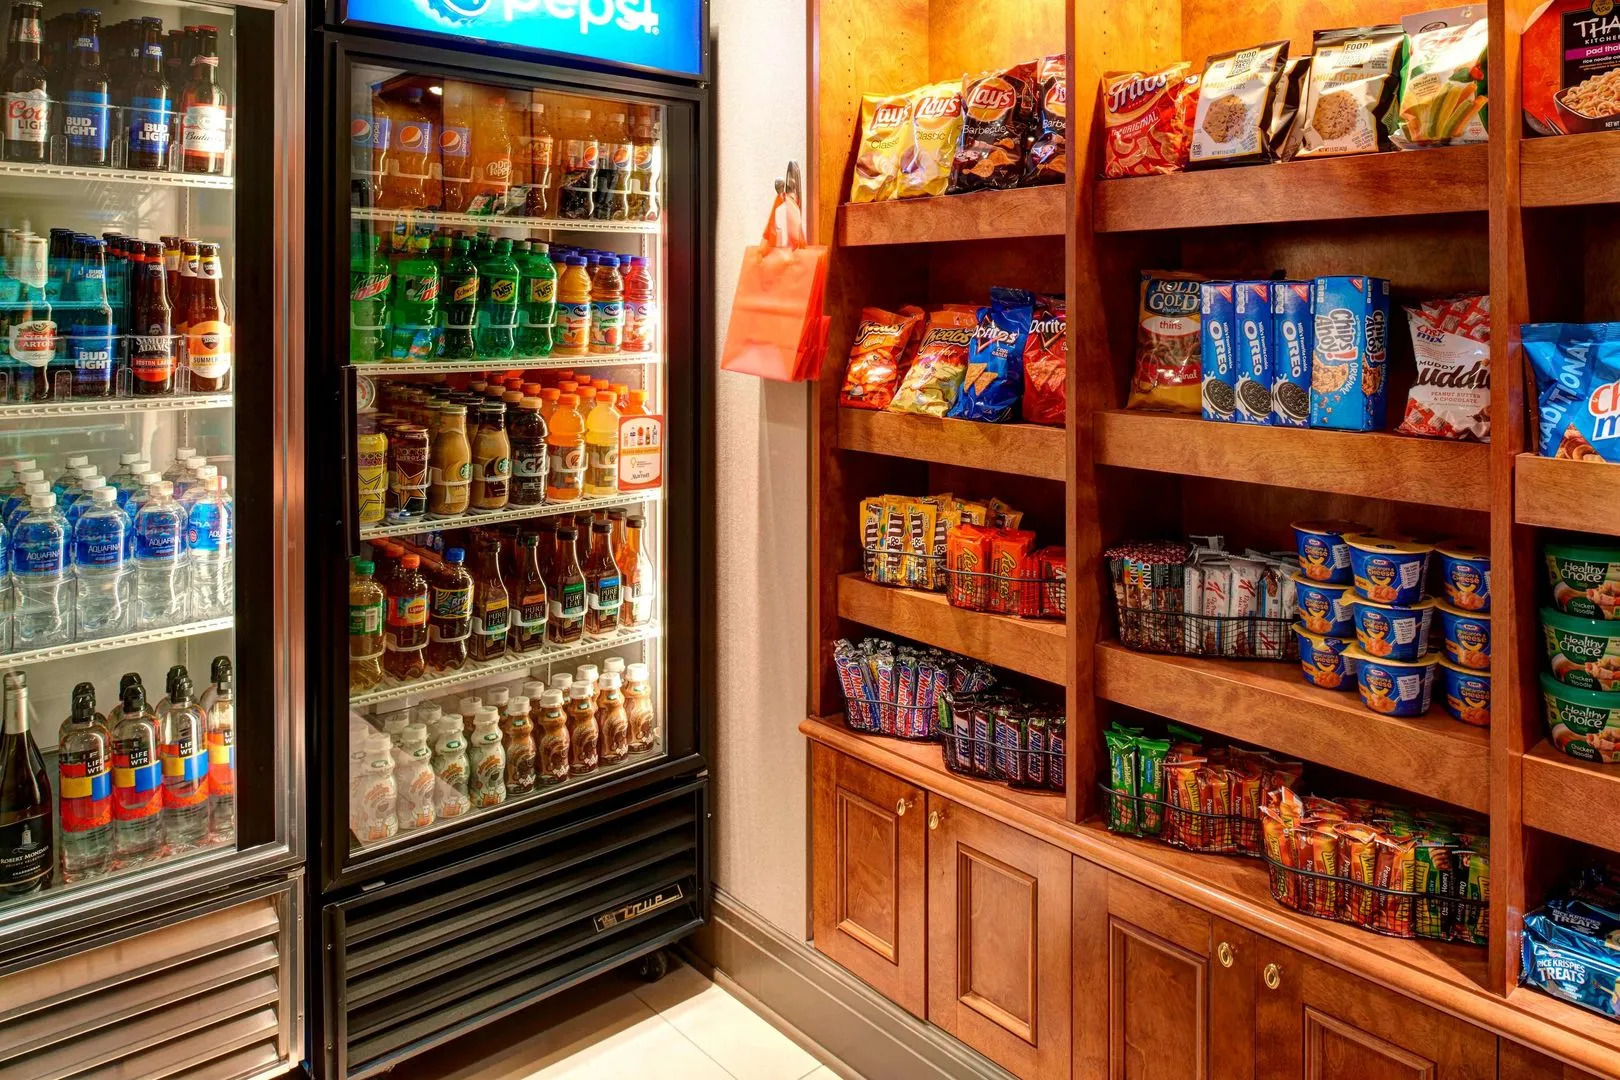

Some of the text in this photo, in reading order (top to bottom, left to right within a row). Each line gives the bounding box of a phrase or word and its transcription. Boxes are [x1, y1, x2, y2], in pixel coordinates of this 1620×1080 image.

[1573, 15, 1620, 38] THA
[1346, 42, 1369, 51] FOOD
[1586, 43, 1620, 56] pad thai
[1237, 51, 1257, 60] FOOD
[968, 85, 1013, 107] Lay's
[1108, 71, 1169, 113] Fritos
[918, 95, 962, 119] Lay's
[66, 116, 92, 127] BUD
[144, 122, 168, 132] BUD
[1122, 111, 1159, 136] ORIGINAL
[64, 126, 97, 137] LIGHT
[962, 124, 1007, 135] Barbecue
[138, 131, 170, 142] LIGHT
[1157, 280, 1199, 294] ROLD
[1150, 293, 1200, 311] GOLD
[1029, 318, 1066, 335] Dorito
[1159, 320, 1182, 330] thins
[1329, 309, 1355, 350] Chips
[974, 321, 1018, 344] Doritos
[1371, 310, 1386, 353] Chips
[138, 344, 170, 353] ADAMS
[1209, 320, 1228, 375] OREO
[1244, 320, 1263, 376] OREO
[1282, 319, 1301, 378] OREO
[79, 351, 108, 360] BUD
[74, 359, 112, 370] LIGHT
[1419, 360, 1455, 370] MUDDY
[1338, 362, 1359, 395] ORIGINAL
[1130, 559, 1139, 585] KIND
[1564, 561, 1606, 576] Healthy
[1143, 563, 1152, 590] KIND
[1560, 568, 1602, 583] Choice
[601, 588, 618, 596] PURE
[565, 594, 583, 602] PURE
[525, 605, 544, 614] PURE
[1571, 600, 1595, 610] Chicken
[488, 609, 506, 619] PURE
[1573, 607, 1595, 616] Noodle
[1564, 633, 1606, 649] Healthy
[1559, 640, 1601, 657] Choice
[1569, 673, 1594, 683] Chicken
[1571, 679, 1593, 688] Noodle
[1564, 704, 1606, 720] Healthy
[1560, 711, 1603, 728] Choice
[180, 741, 193, 750] LIF
[1570, 743, 1595, 753] Chicken
[130, 750, 148, 760] LIFE
[180, 747, 193, 756] WT
[1572, 749, 1594, 760] Noodle
[87, 759, 104, 768] LIFE
[130, 757, 149, 767] WTR
[87, 765, 105, 775] WTR
[0, 855, 24, 864] ROBERT
[1381, 865, 1390, 887] Peanut
[1441, 872, 1449, 893] Honey
[1553, 915, 1601, 930] TREATS
[1553, 960, 1586, 972] KRISPIES
[1538, 968, 1586, 984] TREATS
